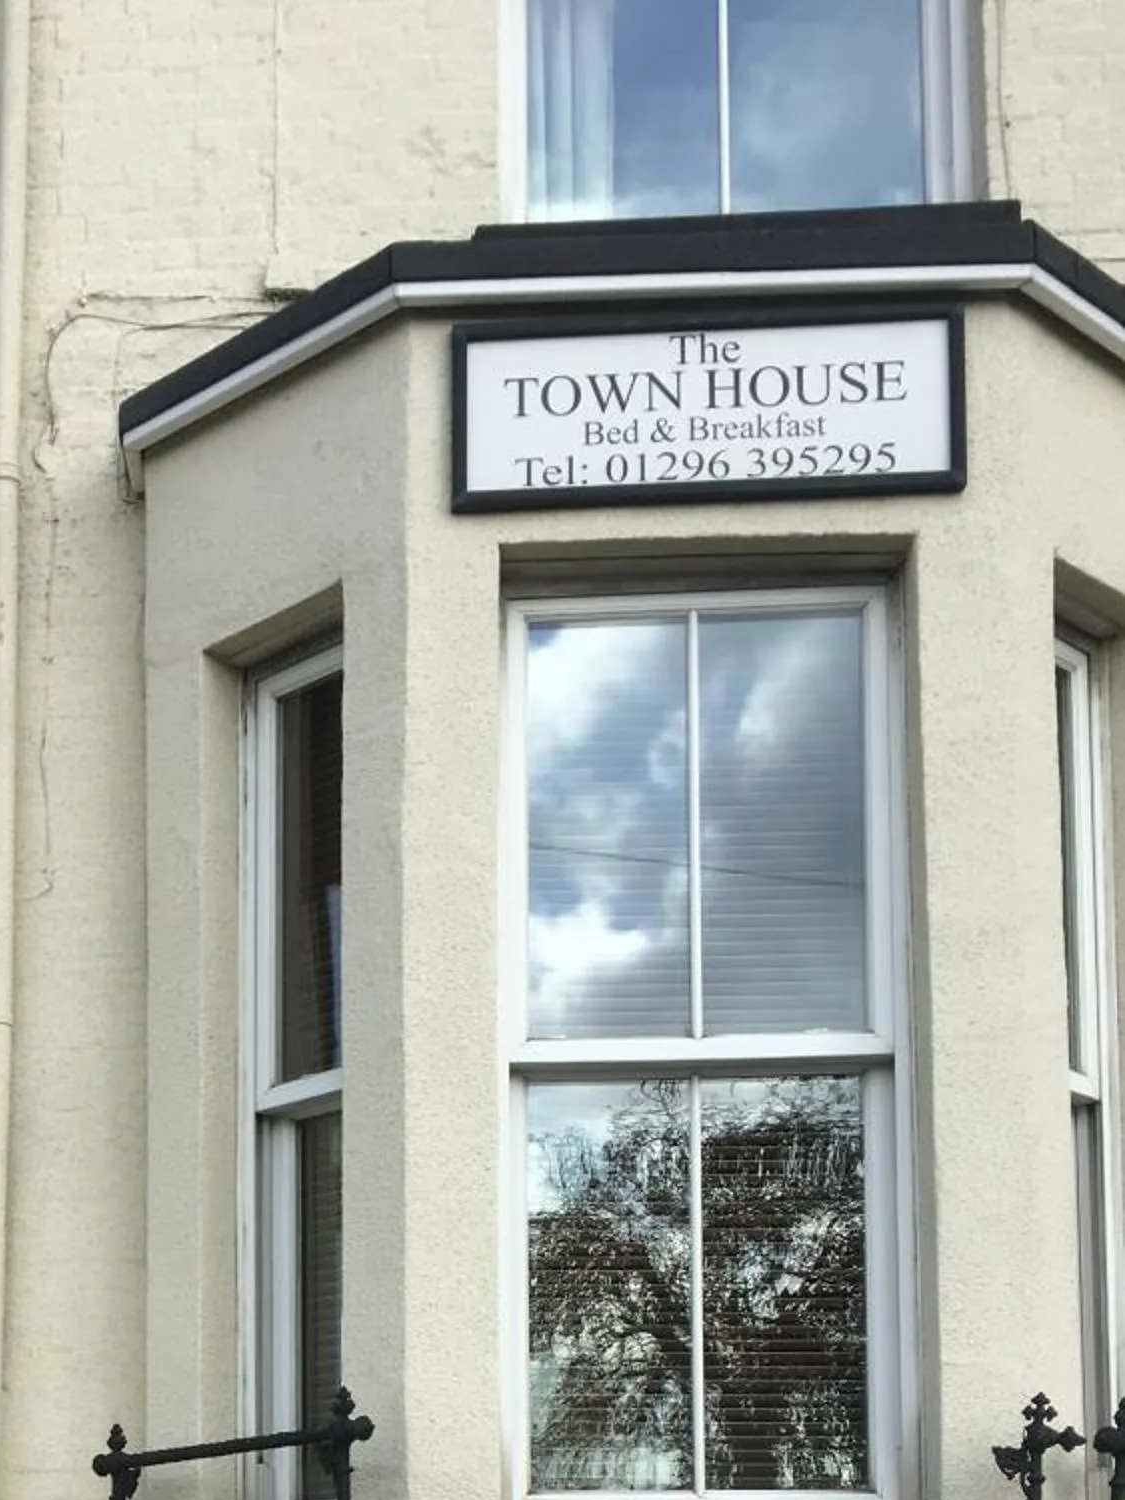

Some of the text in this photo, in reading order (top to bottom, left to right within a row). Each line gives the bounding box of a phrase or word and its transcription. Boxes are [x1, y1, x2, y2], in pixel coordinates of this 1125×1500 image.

[669, 334, 742, 366] The
[504, 360, 908, 418] TOWN HOUSE
[583, 413, 826, 446] Bed & Breakfast
[514, 442, 897, 487] Tel: 01296 395295
